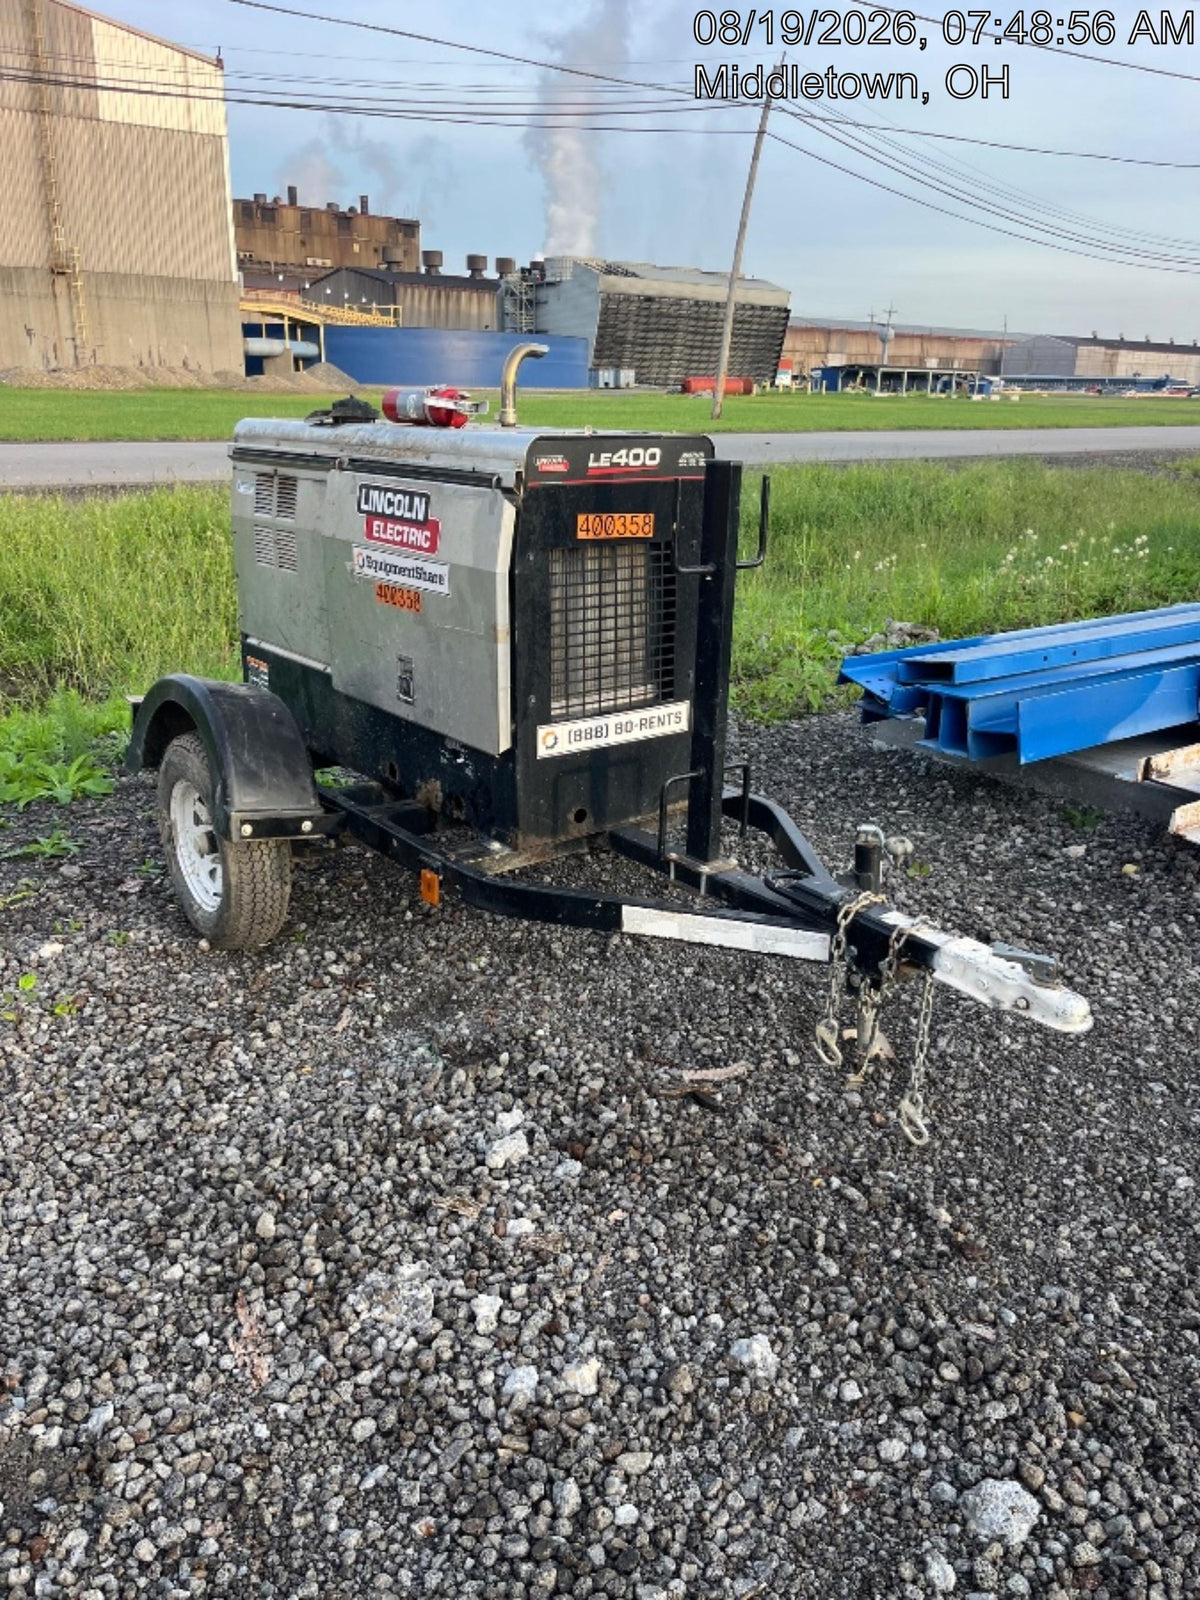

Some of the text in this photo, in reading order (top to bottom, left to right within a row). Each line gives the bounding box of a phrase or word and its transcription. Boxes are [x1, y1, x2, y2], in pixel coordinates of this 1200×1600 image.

[588, 447, 662, 468] LE400
[360, 487, 426, 521] LINCOLN
[372, 520, 431, 548] ELECTRIC
[579, 514, 652, 536] 400358
[365, 555, 446, 586] EquipmentShare
[376, 583, 421, 613] 400358
[568, 711, 683, 745] (888) 80-RENTS
